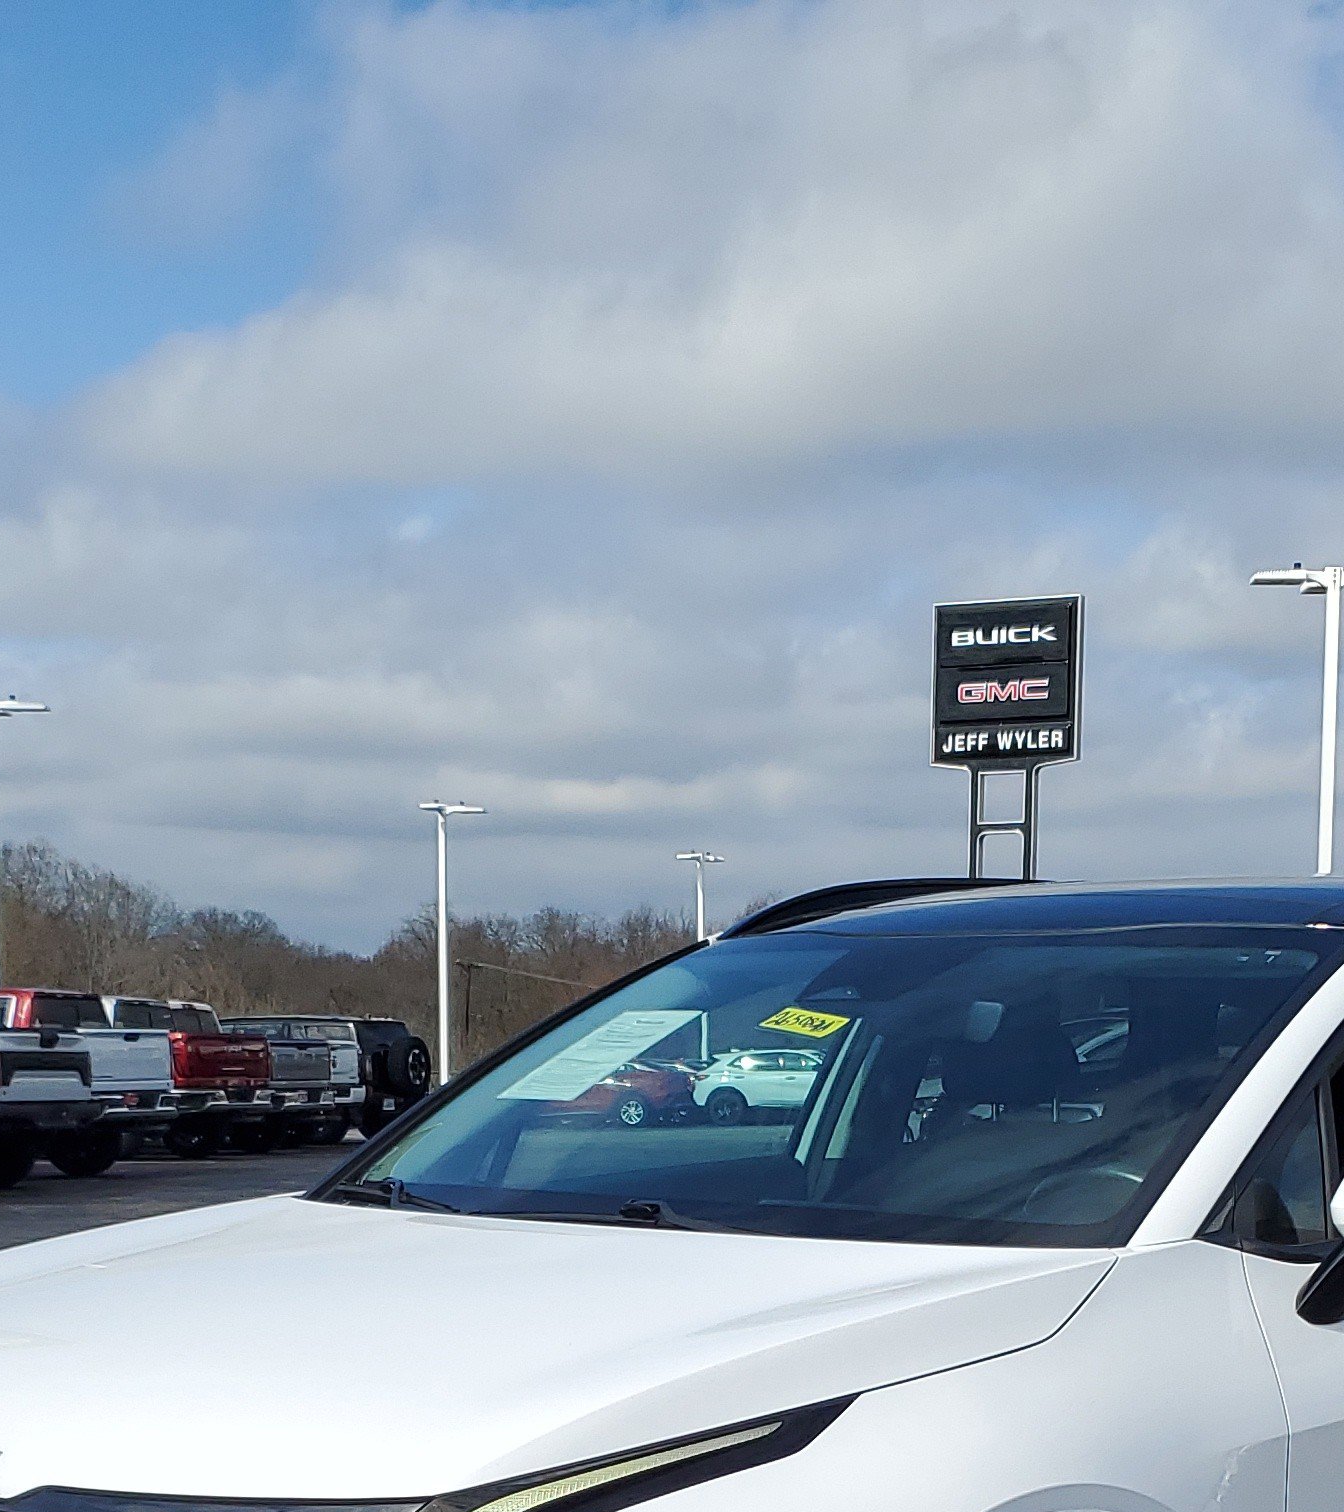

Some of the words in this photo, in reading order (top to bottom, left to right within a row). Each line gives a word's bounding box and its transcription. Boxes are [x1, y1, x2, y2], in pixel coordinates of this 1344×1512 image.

[951, 625, 1057, 647] BUICK
[958, 678, 1049, 703] GMC
[942, 731, 989, 753] JEFF
[997, 729, 1063, 750] WYLER
